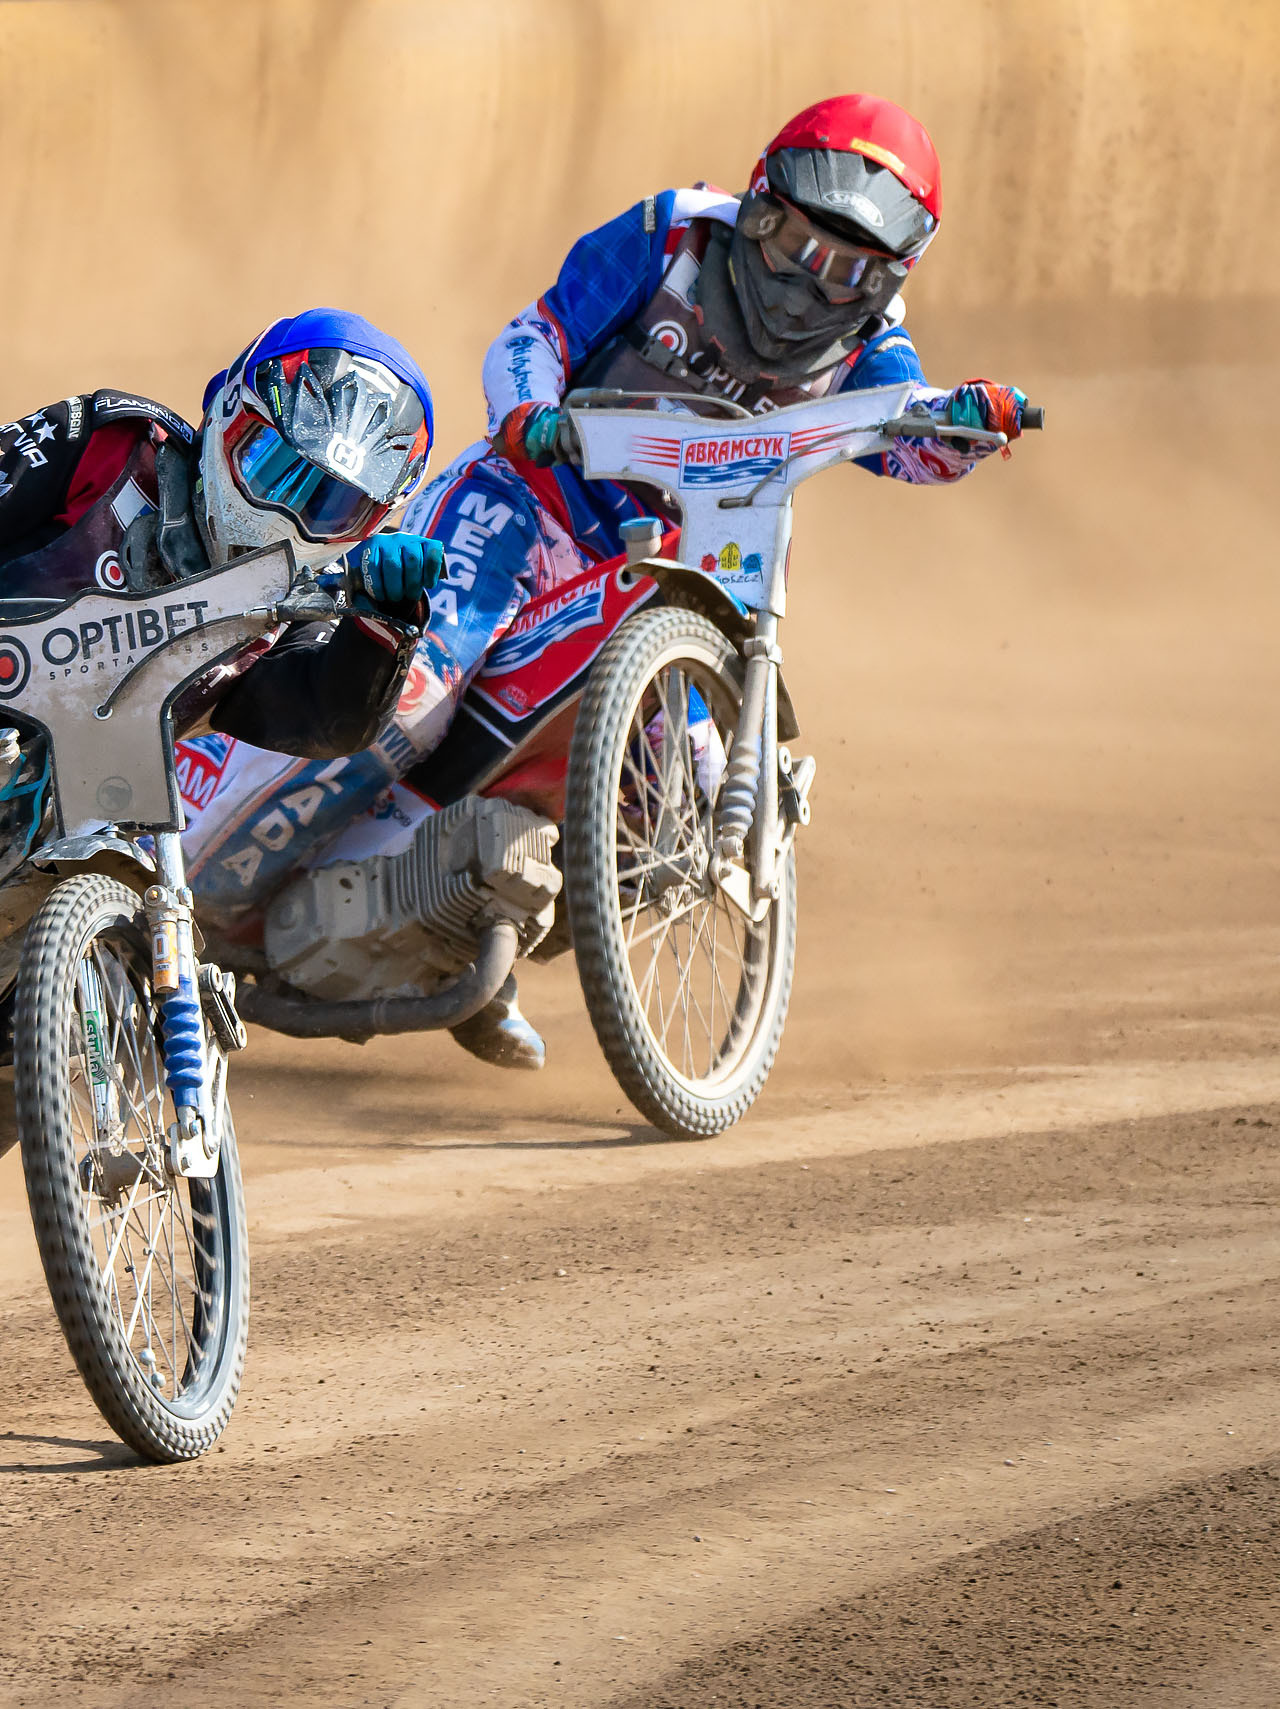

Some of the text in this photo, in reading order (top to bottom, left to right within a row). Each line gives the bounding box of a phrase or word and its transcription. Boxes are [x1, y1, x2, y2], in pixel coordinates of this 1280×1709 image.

[685, 438, 784, 465] ABRAMCZYK
[42, 601, 209, 665] OPTIBET
[49, 655, 135, 680] SPORTA
